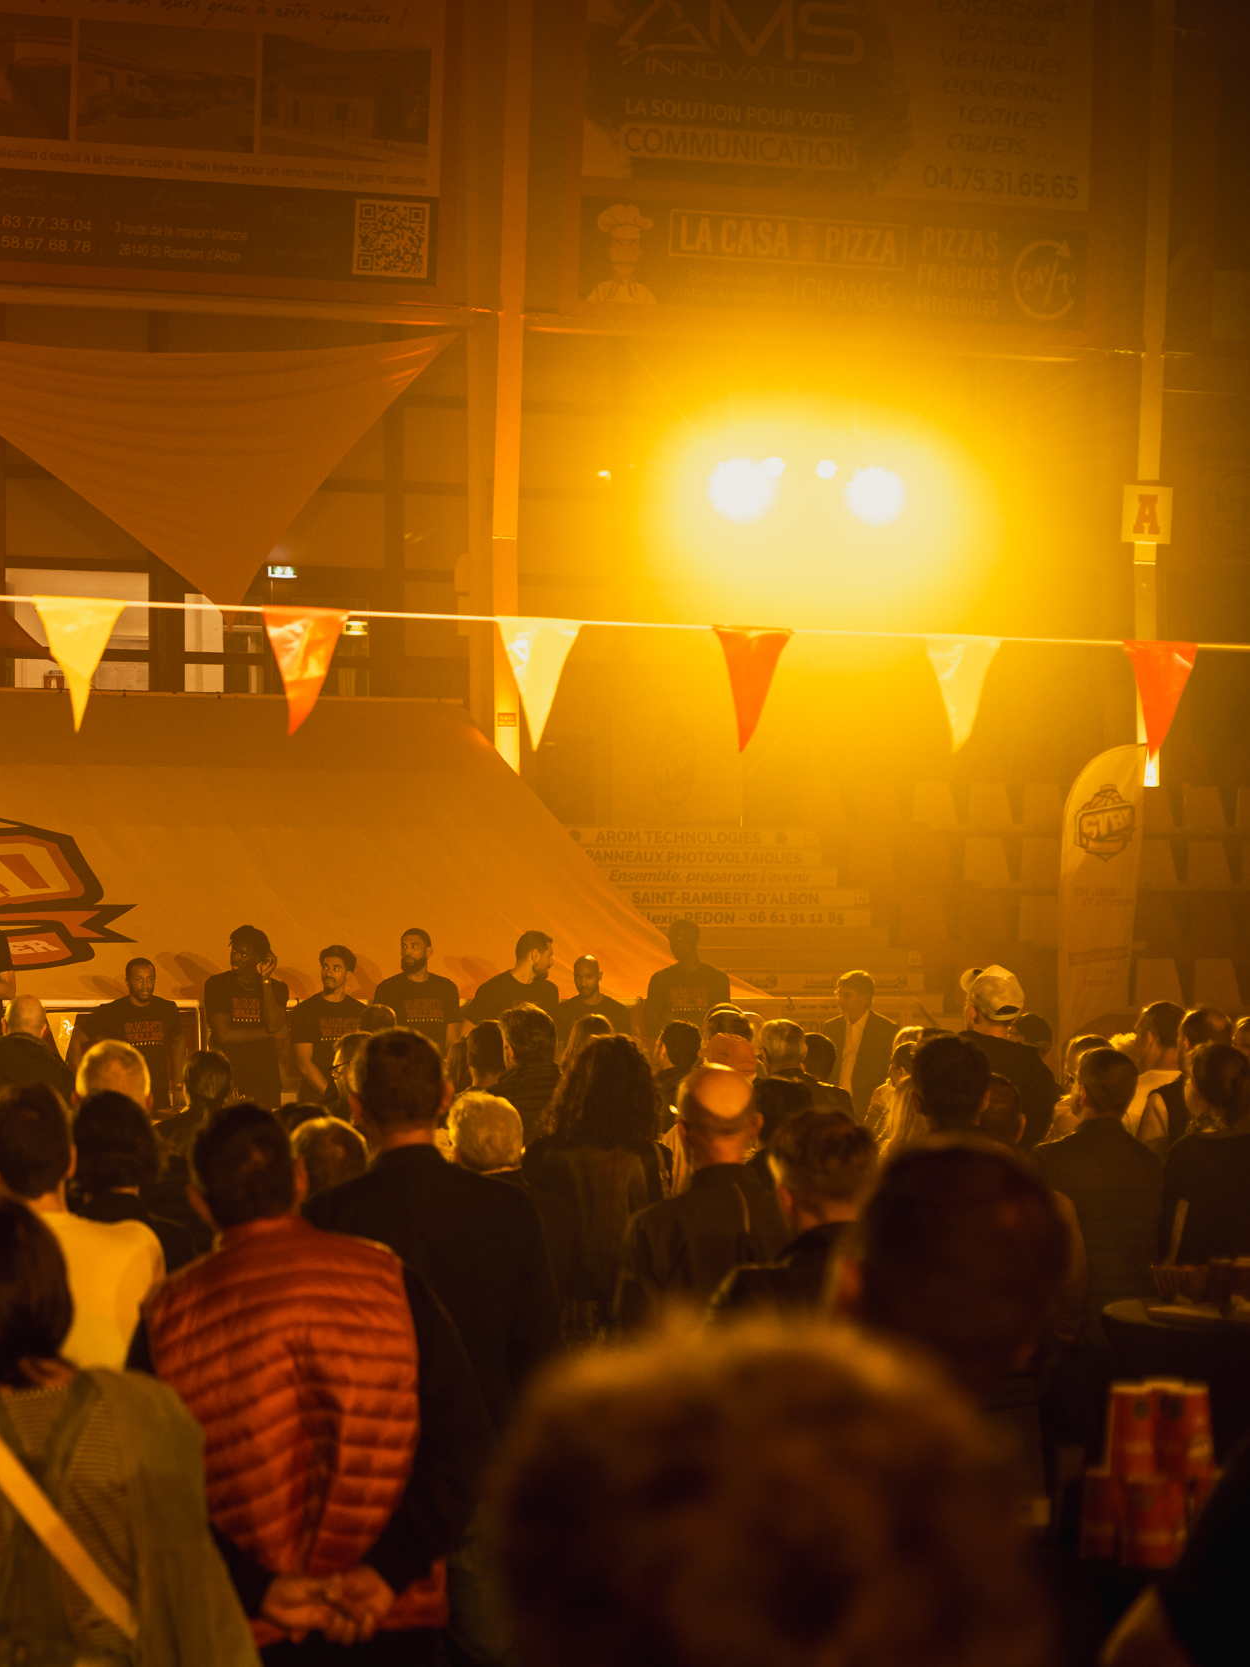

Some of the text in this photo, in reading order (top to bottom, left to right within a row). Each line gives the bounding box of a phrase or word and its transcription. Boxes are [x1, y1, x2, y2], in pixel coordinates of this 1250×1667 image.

[274, 3, 312, 20] notre
[320, 7, 392, 35] signature
[644, 56, 836, 89] INNOVATION
[942, 76, 1064, 106] COVERING
[625, 97, 854, 132] LA SOLUTION POUR VOTRE
[956, 105, 1049, 130] TEXTILES
[41, 149, 81, 164] d'enduit
[105, 154, 135, 167] chaux
[624, 126, 856, 168] COMMUNICATION
[947, 133, 1027, 156] OBJETS
[923, 164, 1079, 200] 04.75.31.65.65
[122, 222, 147, 236] route
[150, 224, 162, 237] de
[164, 225, 173, 238] la
[176, 226, 210, 240] maison
[212, 227, 249, 242] blanche
[679, 215, 713, 252] LA
[720, 218, 790, 257] CASA
[824, 225, 897, 264] PIZZA
[921, 226, 1000, 261] PIZZAS
[164, 246, 204, 261] Rambert
[801, 276, 895, 310] CHANAS
[1133, 494, 1160, 536] A
[595, 830, 762, 845] AROM TECHNOLOGIES
[585, 849, 663, 864] PANNEAUX
[608, 869, 813, 886] Ensemble, préparons l'avenir
[631, 891, 820, 905] SAINT-RAMBERT-D'ALBON
[749, 912, 767, 925] 06
[770, 912, 786, 925] 61
